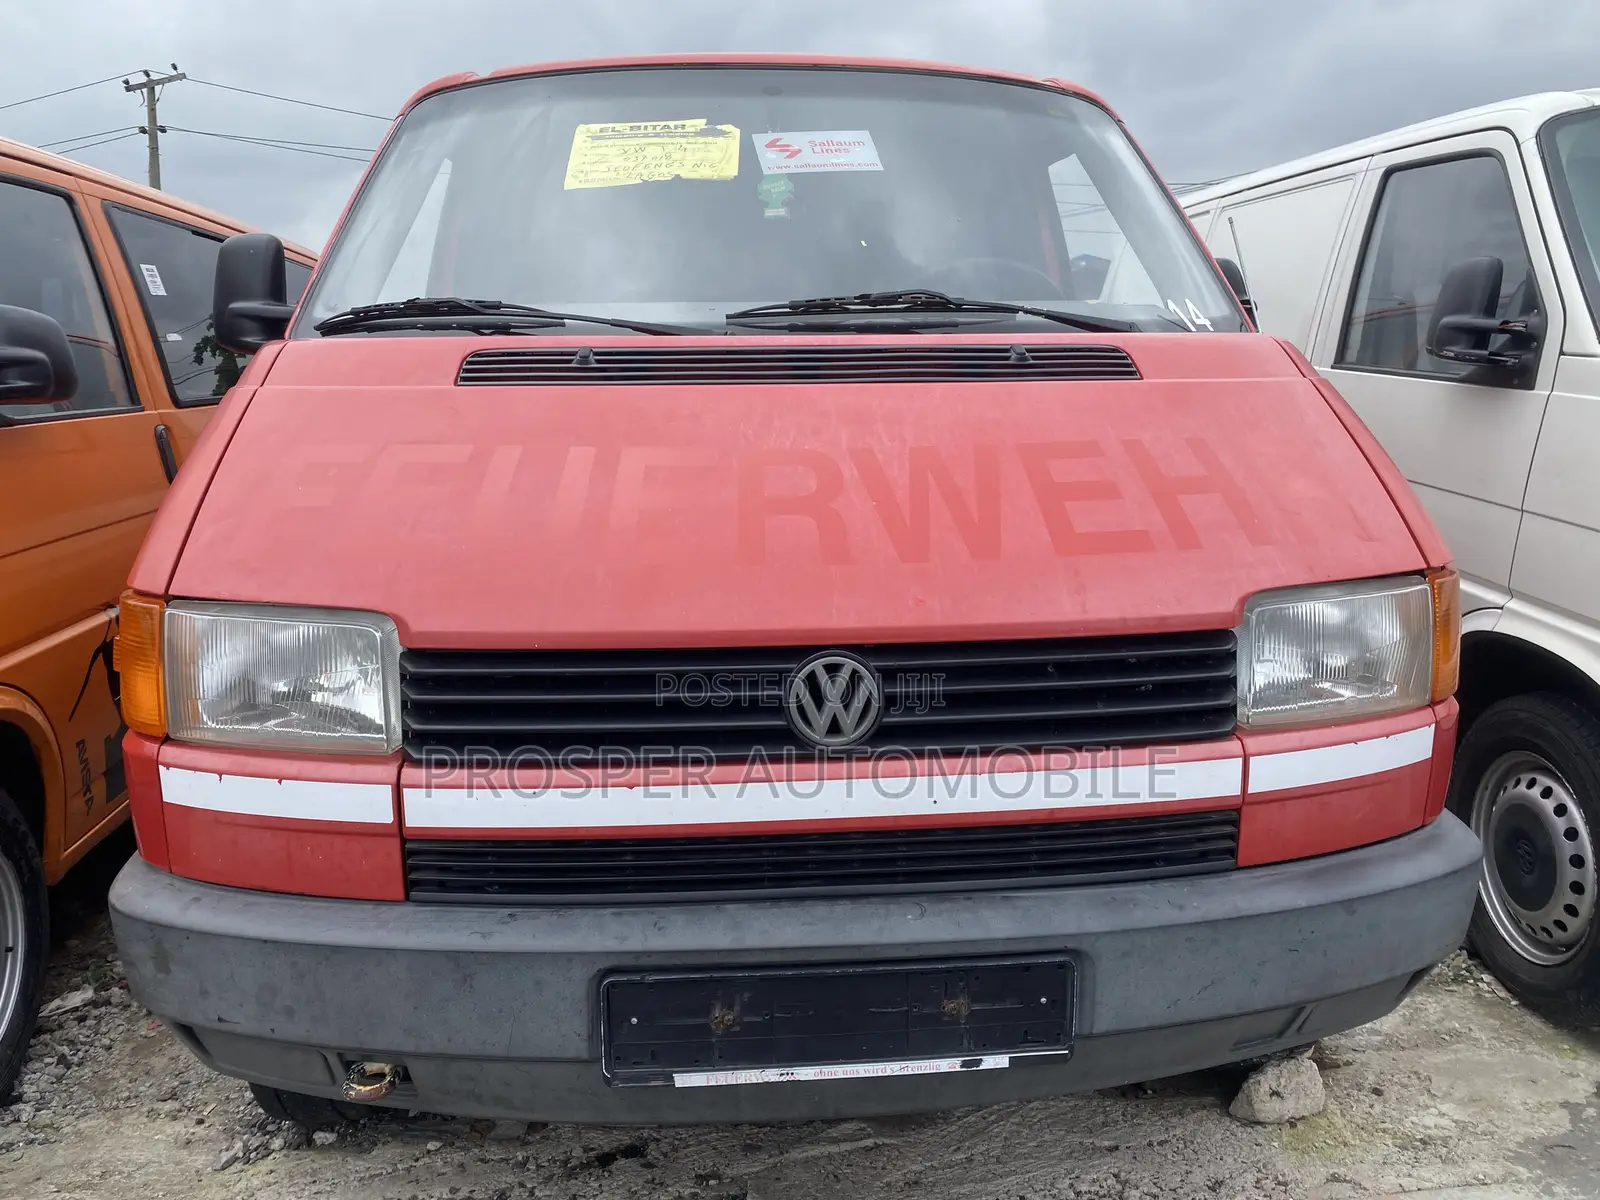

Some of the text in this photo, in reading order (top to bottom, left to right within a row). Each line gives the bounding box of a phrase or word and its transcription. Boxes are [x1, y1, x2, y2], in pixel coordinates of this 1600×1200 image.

[599, 124, 687, 134] EL-BITAR
[808, 139, 866, 148] Sallaum
[812, 146, 851, 154] Lines
[768, 161, 879, 170] www.sallaumlines.com
[1166, 298, 1215, 332] 14
[250, 437, 1378, 565] FEUERWEH
[705, 1071, 797, 1086] FEUERW
[813, 1068, 840, 1078] ohne
[842, 1067, 861, 1077] uns
[863, 1064, 895, 1076] wird's
